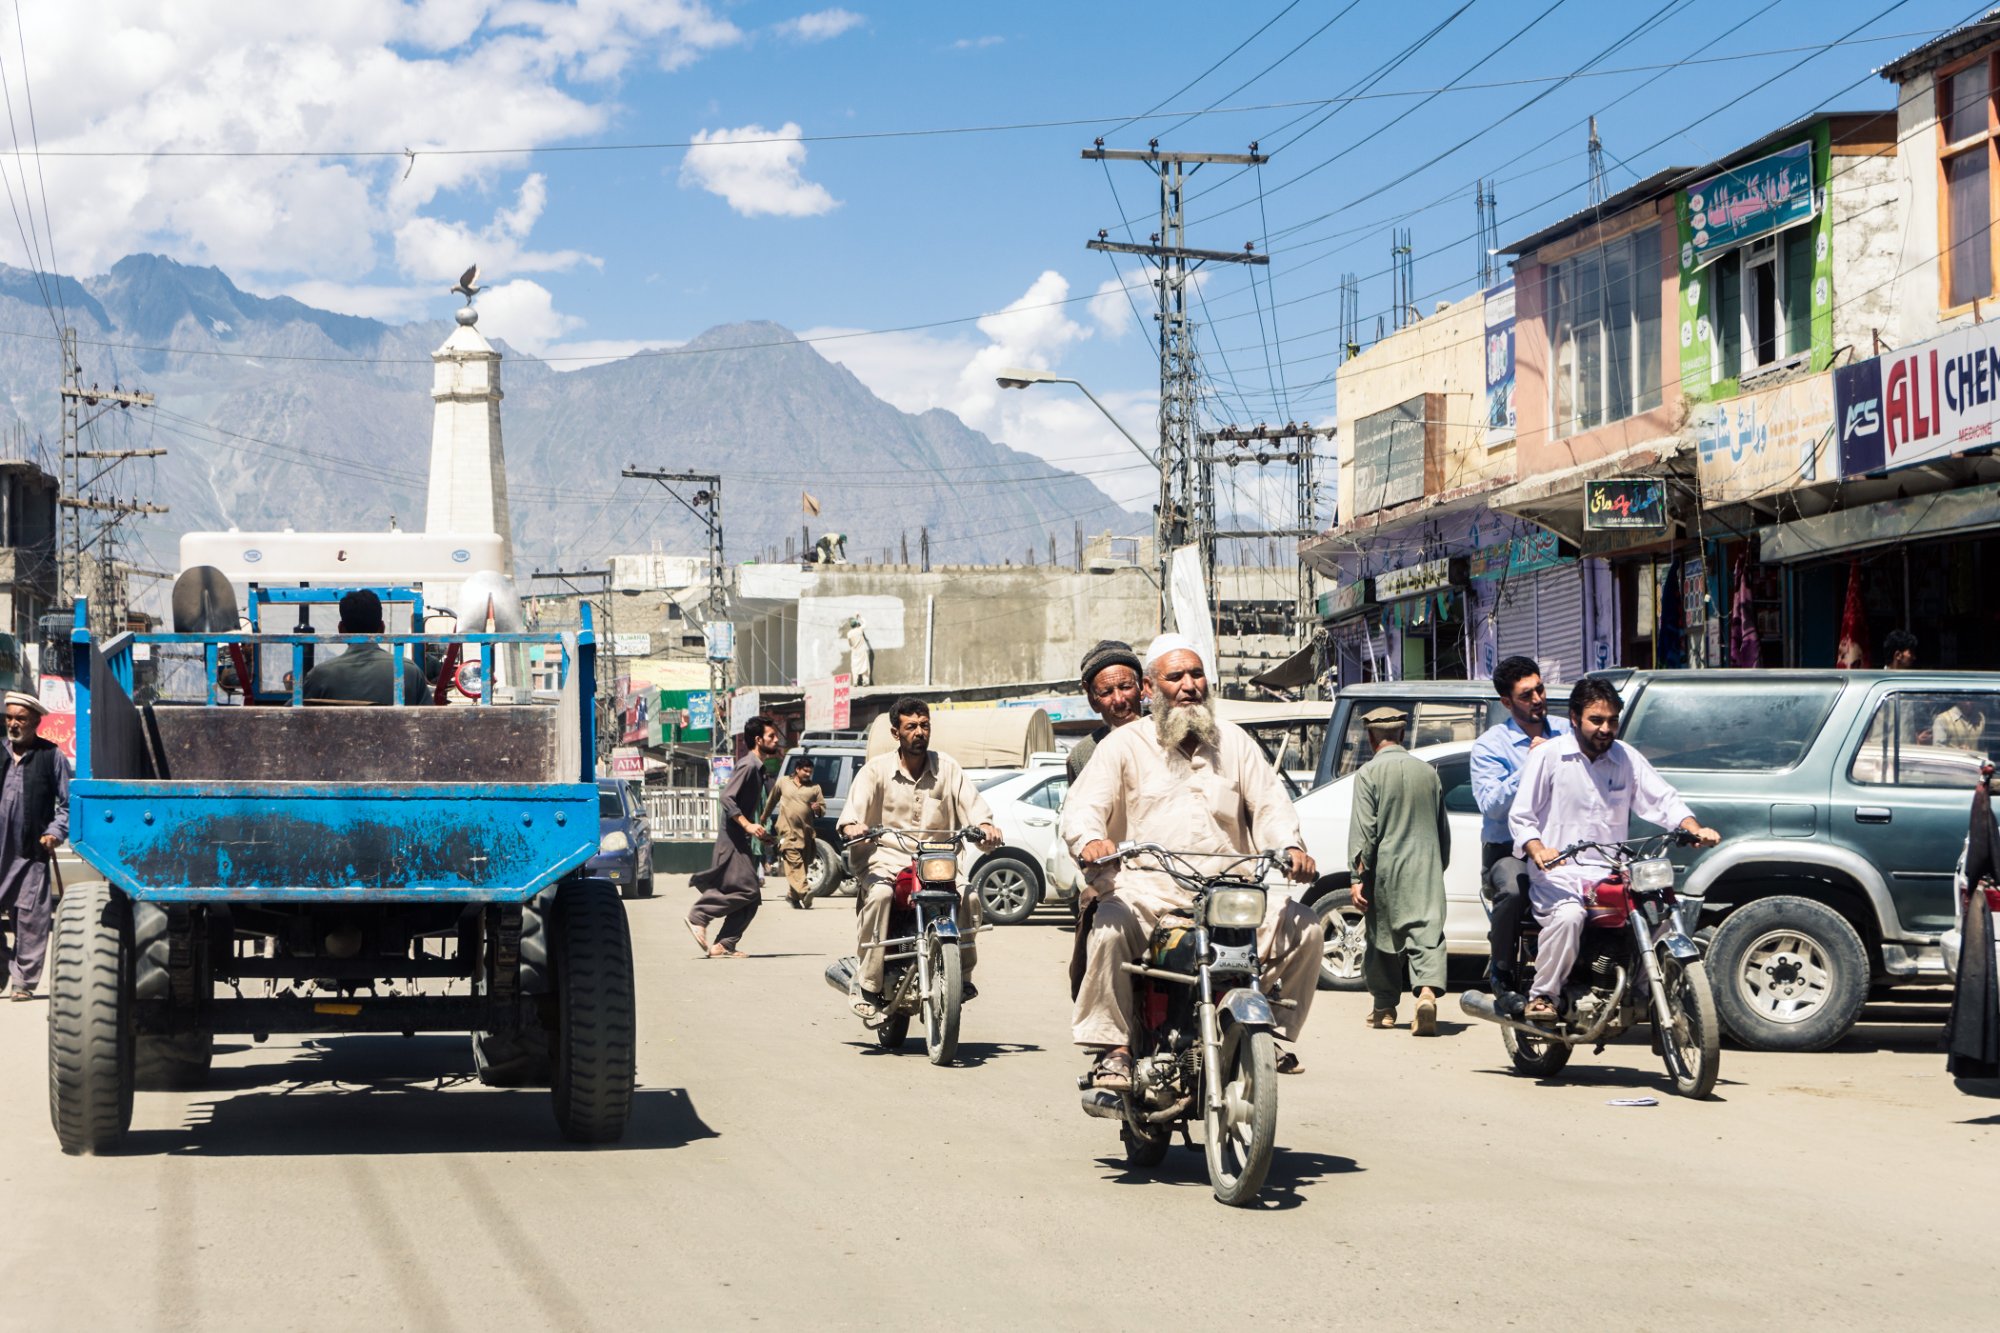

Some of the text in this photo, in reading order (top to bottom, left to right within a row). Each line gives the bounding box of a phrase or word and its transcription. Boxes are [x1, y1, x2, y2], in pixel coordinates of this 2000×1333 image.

[1886, 348, 1941, 457] ALI
[1958, 422, 1993, 442] MEDICINE
[617, 760, 641, 770] ATM
